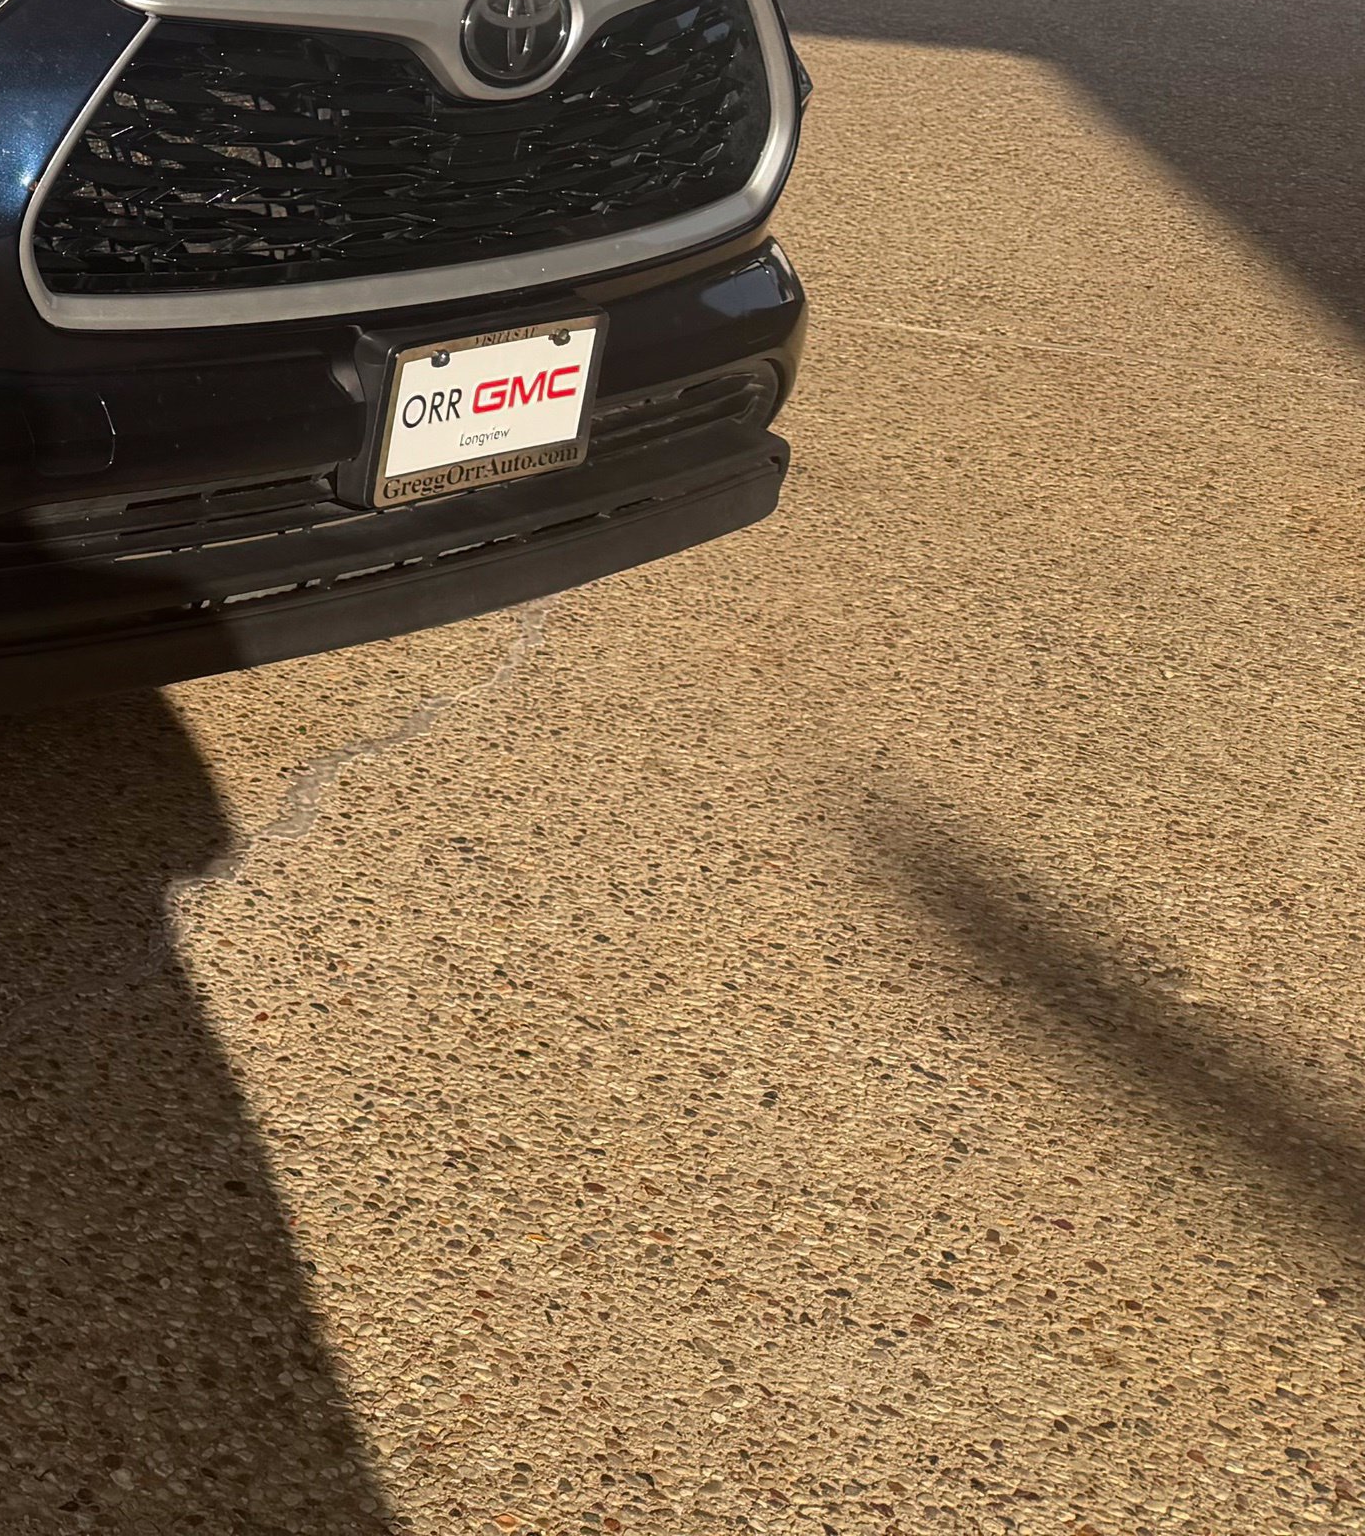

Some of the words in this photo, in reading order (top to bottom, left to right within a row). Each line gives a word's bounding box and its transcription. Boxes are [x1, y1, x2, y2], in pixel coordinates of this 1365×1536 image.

[403, 388, 463, 428] ORR
[472, 365, 580, 413] GMC
[459, 427, 510, 447] Longview
[383, 446, 578, 499] GreggOrrAuto.com
